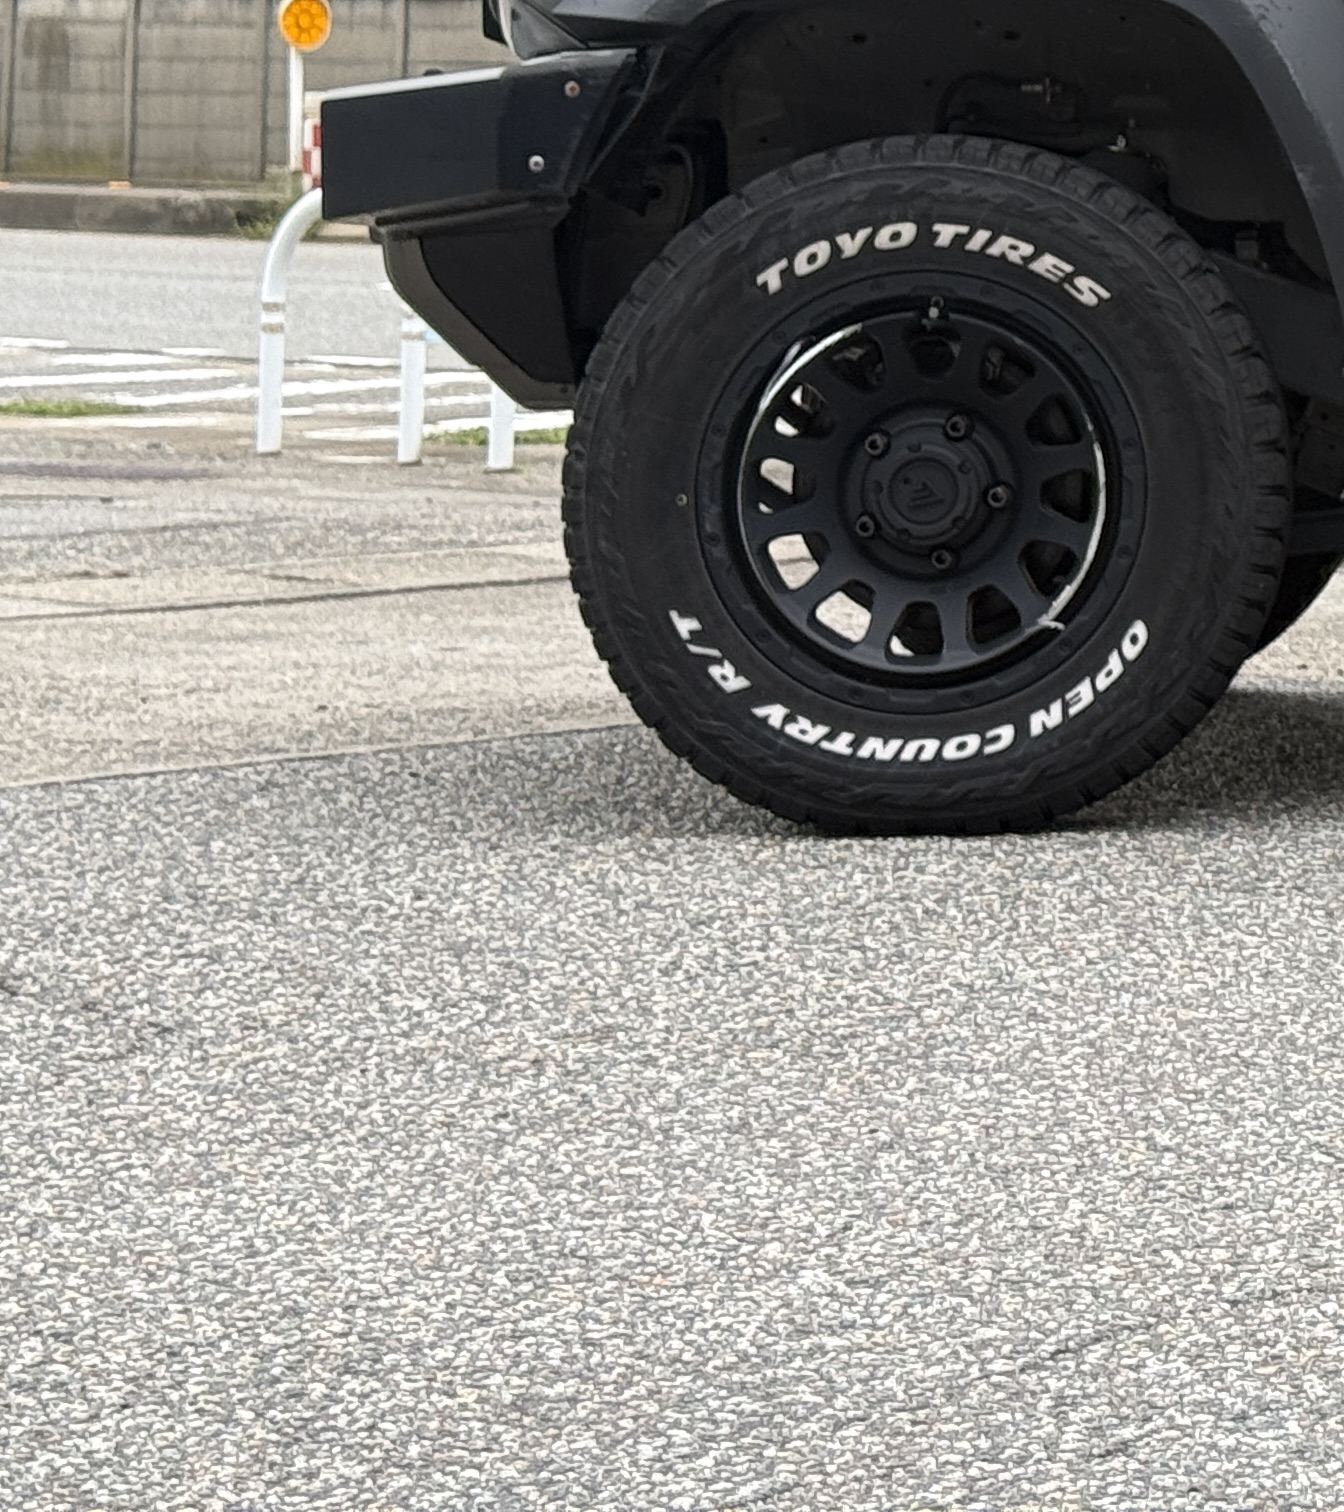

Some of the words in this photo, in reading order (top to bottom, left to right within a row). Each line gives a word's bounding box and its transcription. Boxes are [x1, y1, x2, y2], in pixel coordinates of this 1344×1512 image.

[755, 220, 919, 296] TOYO
[931, 221, 1112, 308] TIRES
[667, 608, 753, 695] R/T
[1028, 618, 1150, 739] OPEN
[749, 702, 1017, 763] COUNTRY
